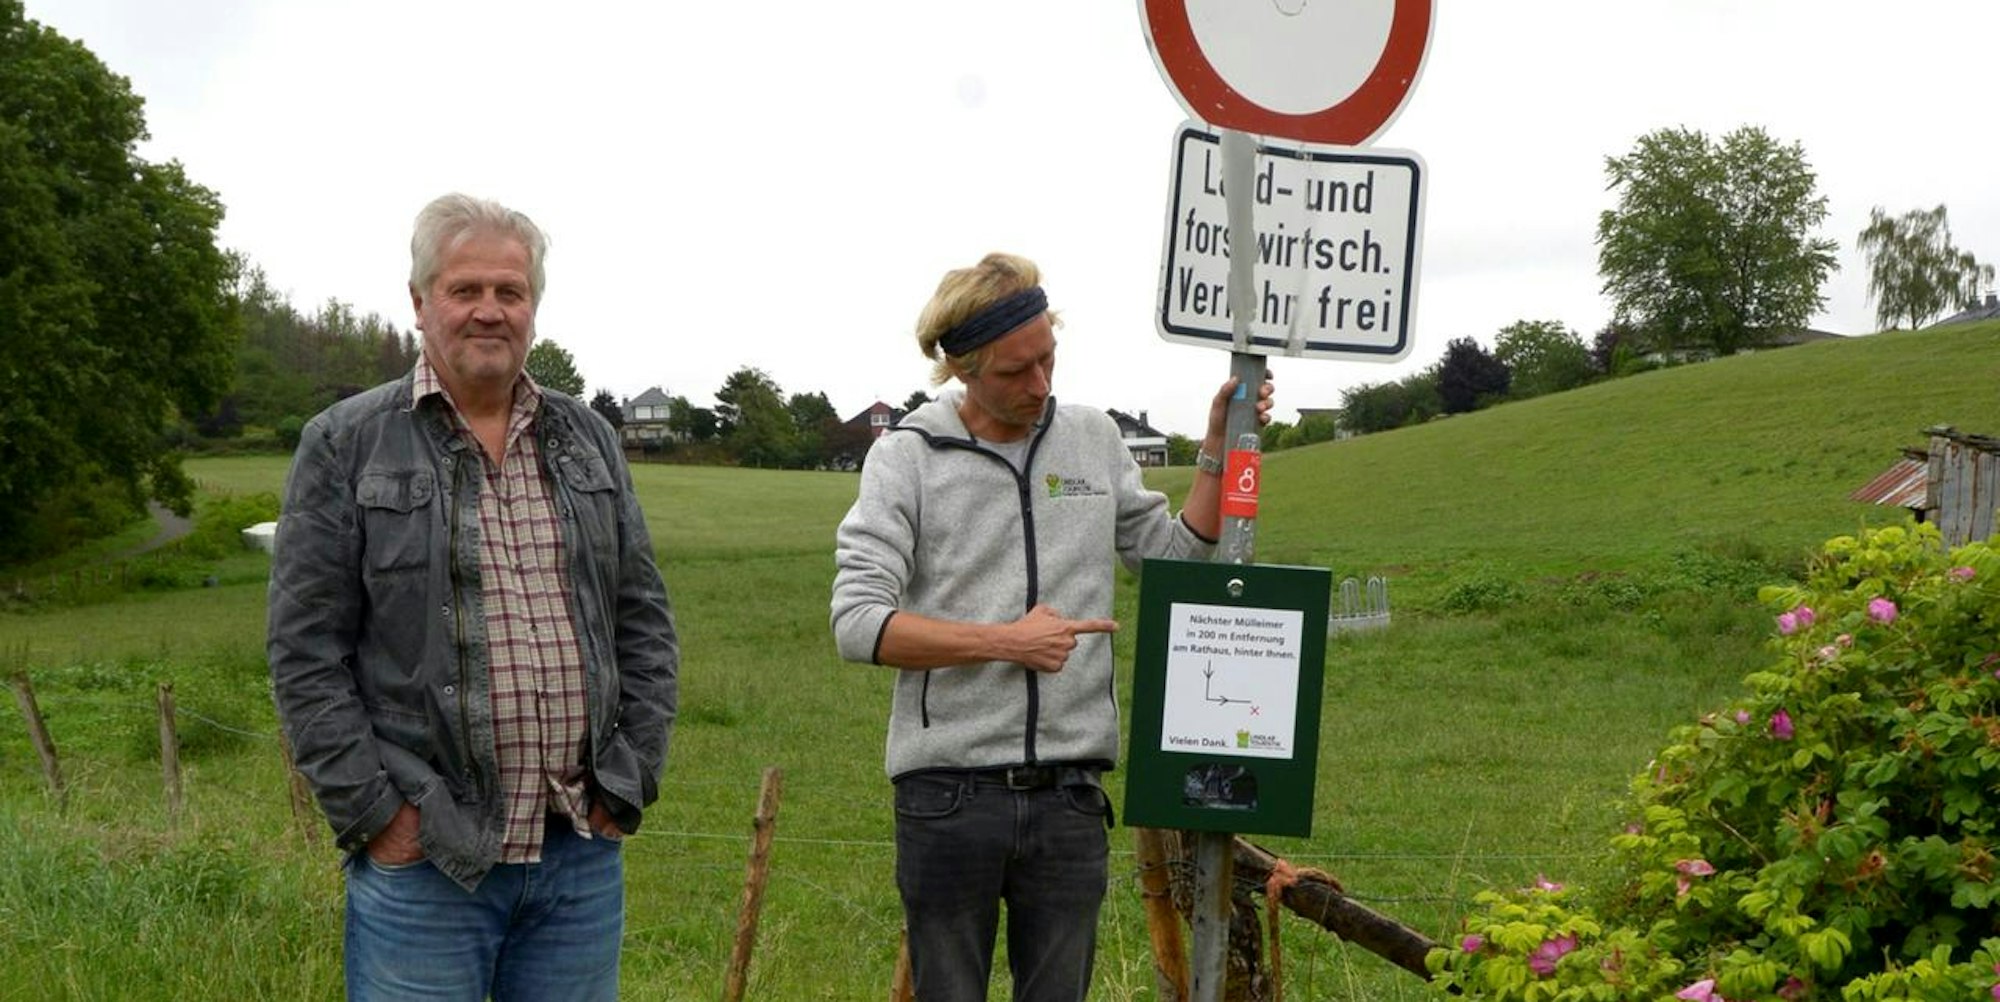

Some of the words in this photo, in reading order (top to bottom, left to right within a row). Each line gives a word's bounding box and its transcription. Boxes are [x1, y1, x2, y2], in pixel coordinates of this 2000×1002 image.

[1203, 149, 1293, 205] Ld-
[1306, 171, 1374, 214] und
[1185, 207, 1390, 274] forswirtsch.
[1179, 266, 1299, 326] Verhr
[1318, 285, 1392, 332] frei
[1190, 614, 1232, 626] Nächster
[1235, 617, 1284, 629] Mülleimer
[1186, 629, 1196, 638] in
[1198, 630, 1216, 639] 200
[1230, 631, 1285, 646] Entfernung
[1190, 644, 1232, 656] Rathaus,
[1234, 647, 1264, 657] hinter
[1265, 649, 1297, 659] Ihnen.
[1169, 735, 1199, 746] Vielen
[1201, 737, 1229, 748] Dank.
